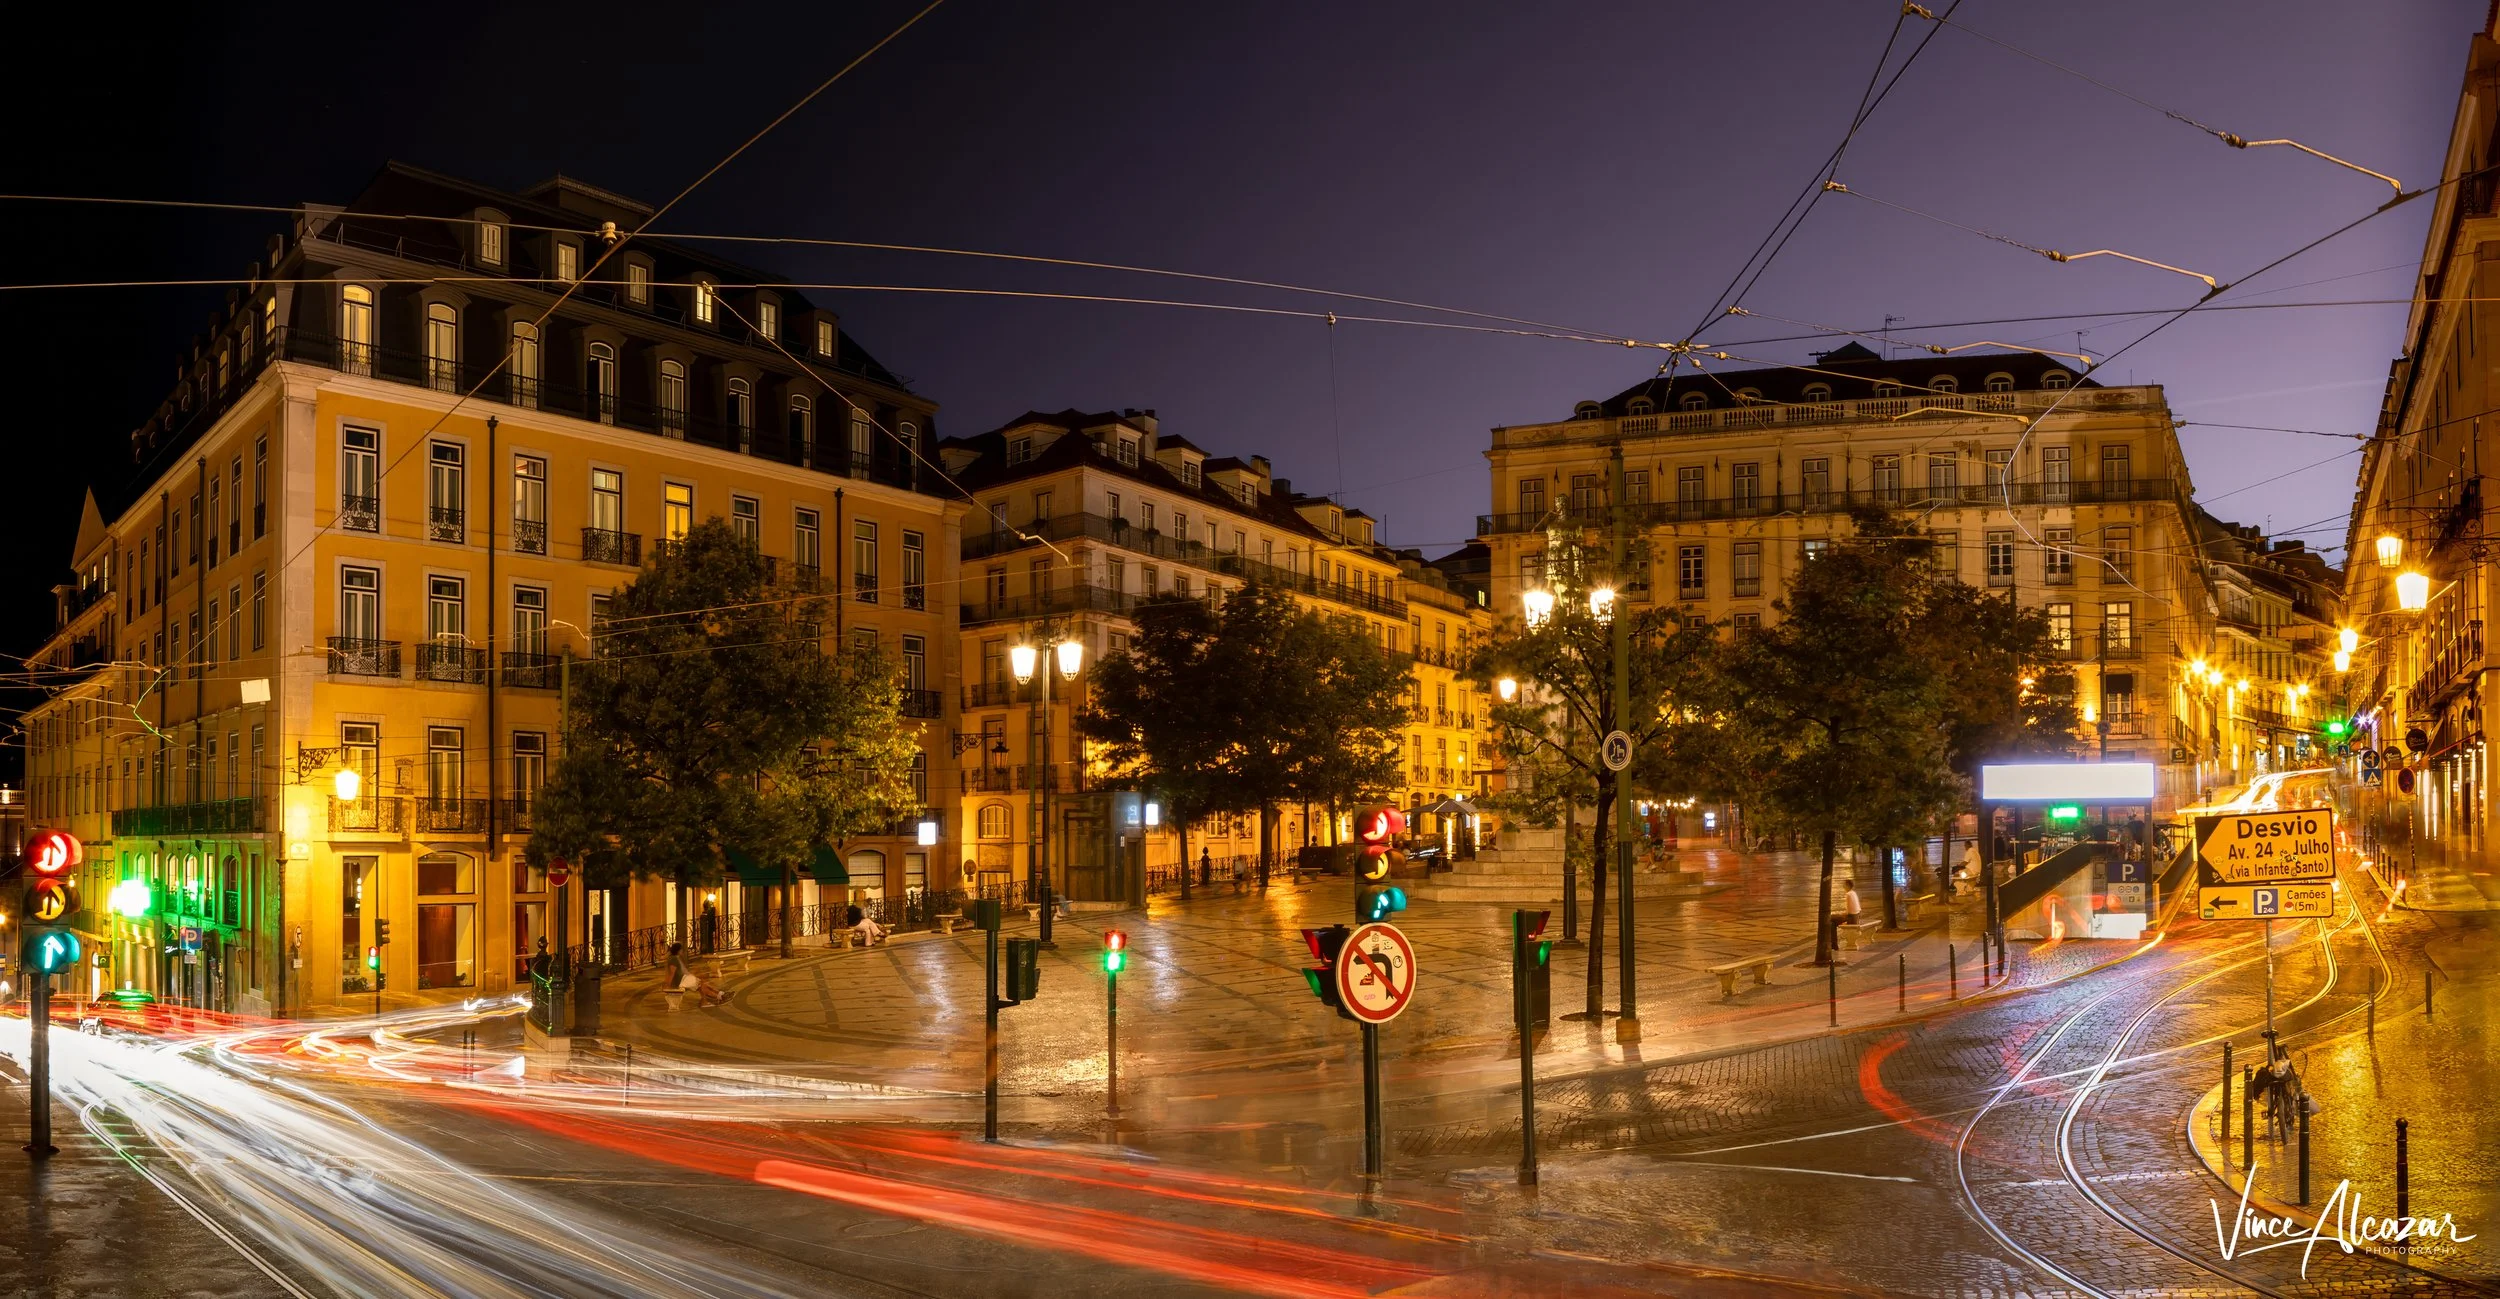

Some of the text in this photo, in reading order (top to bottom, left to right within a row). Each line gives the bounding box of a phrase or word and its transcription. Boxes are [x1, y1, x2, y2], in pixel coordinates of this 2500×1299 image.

[2236, 815, 2318, 839] Desvio
[2228, 844, 2250, 860] Av.
[2254, 842, 2274, 858] 24
[2293, 839, 2330, 857] Julho
[2122, 863, 2135, 882] P
[2230, 863, 2250, 879] (via
[2254, 862, 2290, 877] Infante
[2294, 858, 2329, 875] Santo)
[2256, 890, 2273, 914] P
[2287, 889, 2326, 900] Camões
[2294, 901, 2319, 912] (5m)
[185, 929, 198, 949] P
